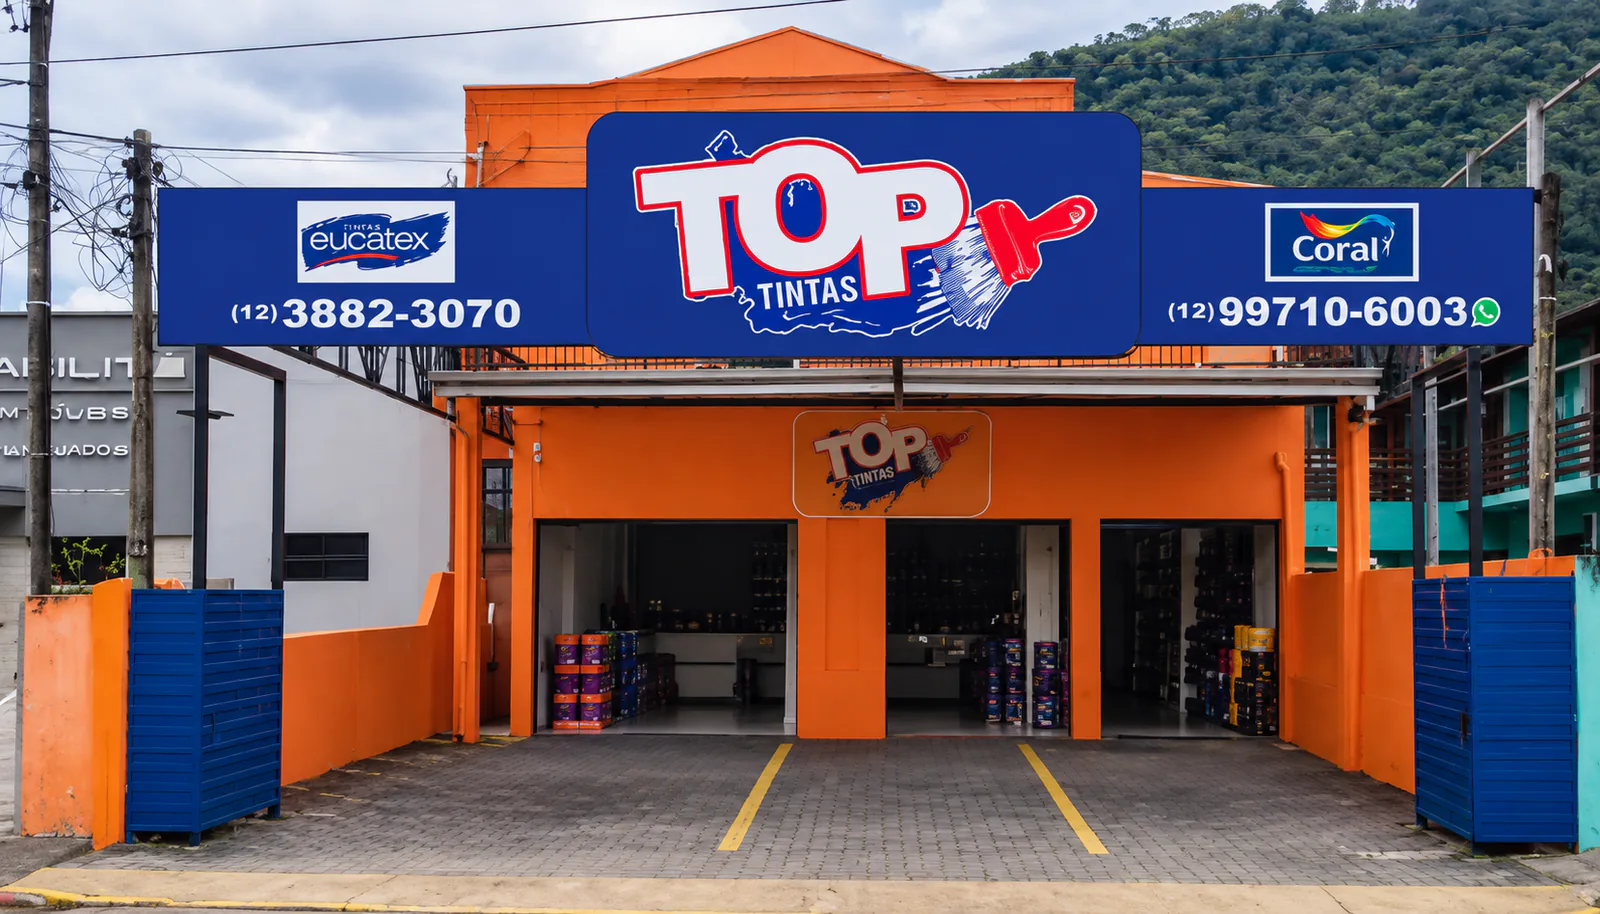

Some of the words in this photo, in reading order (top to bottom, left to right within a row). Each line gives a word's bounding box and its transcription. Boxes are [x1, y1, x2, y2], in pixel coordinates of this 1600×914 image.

[633, 137, 971, 301] TOP
[310, 228, 430, 251] eucatex
[1292, 235, 1379, 262] Coral
[757, 275, 858, 310] TINTAS
[231, 304, 278, 324] (12)
[282, 298, 521, 328] 3882-3070
[1168, 302, 1214, 323] (12)
[1219, 296, 1468, 326] 99710-6003
[812, 420, 928, 482] TOP
[853, 466, 895, 489] TINTAS
